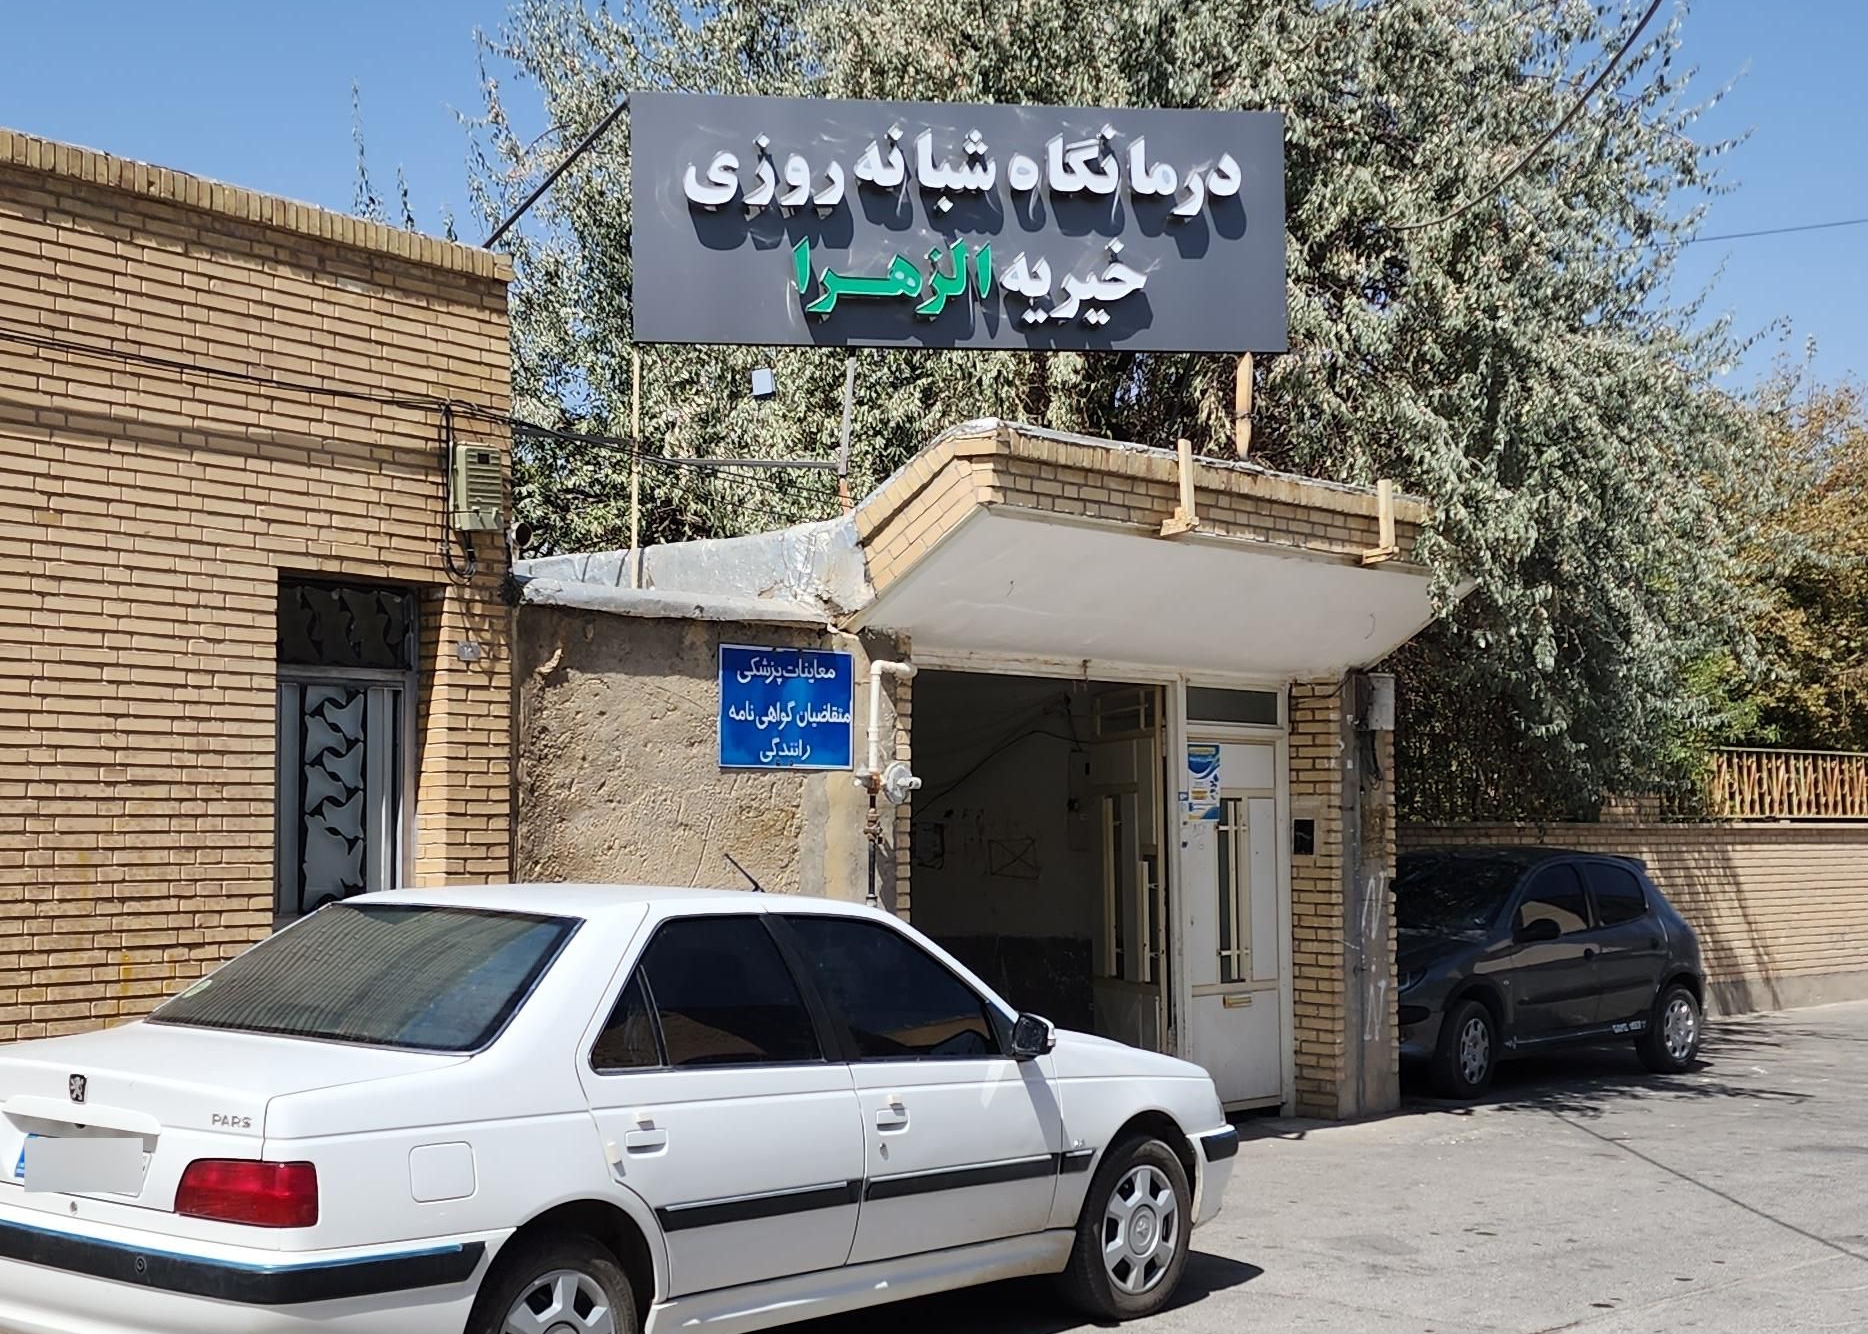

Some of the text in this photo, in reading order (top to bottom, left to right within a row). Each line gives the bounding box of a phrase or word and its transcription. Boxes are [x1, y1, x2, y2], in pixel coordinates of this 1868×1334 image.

[1007, 123, 1242, 218] درمانگاه
[792, 237, 1148, 326] خیریه الزهرا
[736, 656, 836, 686] معاینات پزشکی
[796, 701, 852, 728] متقاضیان
[759, 737, 811, 763] رانندگی
[212, 1113, 252, 1129] PARS
